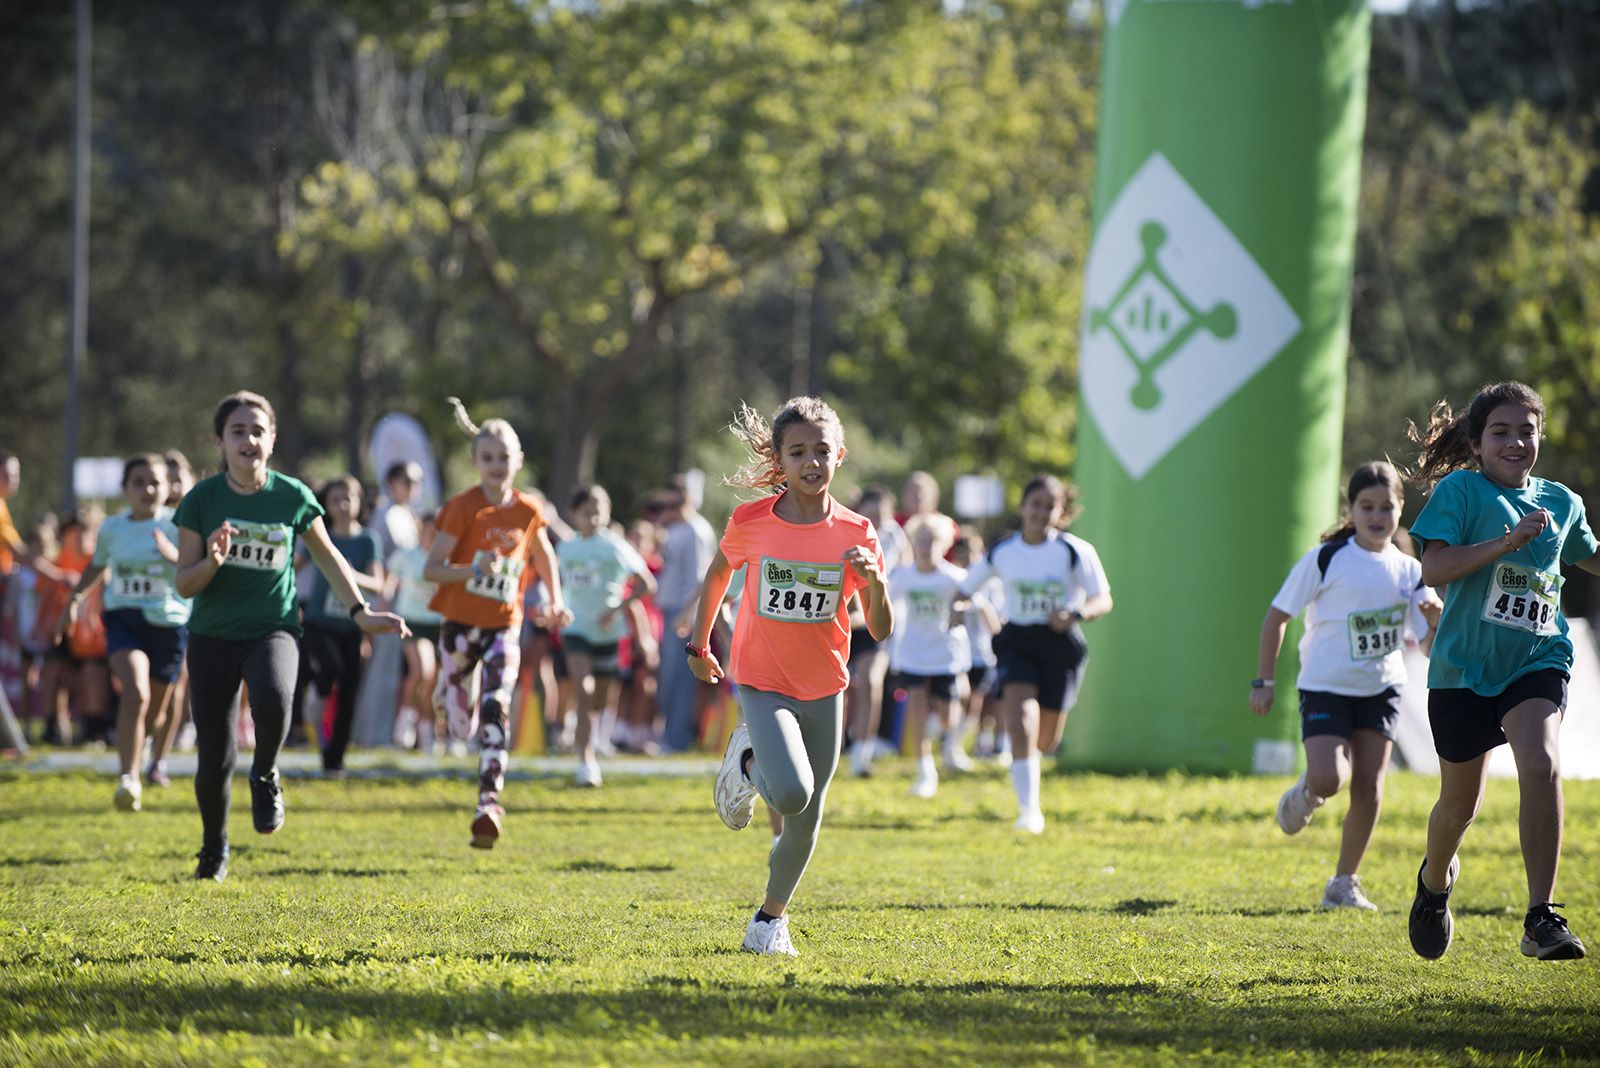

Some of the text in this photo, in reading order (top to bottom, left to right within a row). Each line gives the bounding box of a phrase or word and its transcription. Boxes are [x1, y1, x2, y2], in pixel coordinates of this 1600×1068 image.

[229, 544, 274, 562] 4614
[768, 568, 793, 580] CROS
[1502, 574, 1528, 586] CROS
[768, 588, 826, 612] 2847
[1495, 593, 1549, 624] 4588
